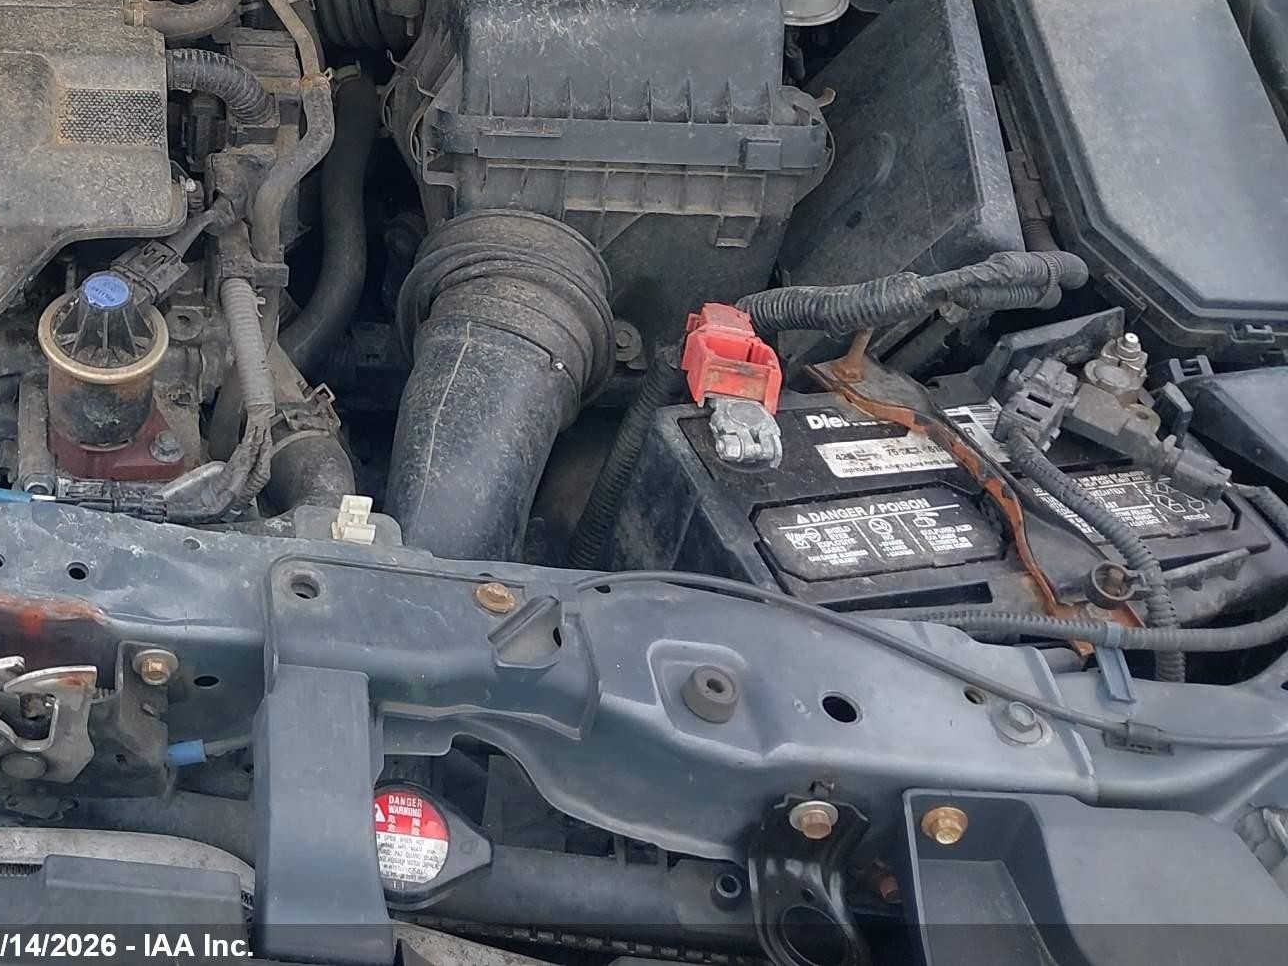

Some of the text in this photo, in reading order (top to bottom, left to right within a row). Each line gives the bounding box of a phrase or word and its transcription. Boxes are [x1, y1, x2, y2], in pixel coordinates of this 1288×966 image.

[808, 506, 869, 523] DANGER
[879, 498, 931, 514] POISON
[388, 794, 423, 808] DANGER
